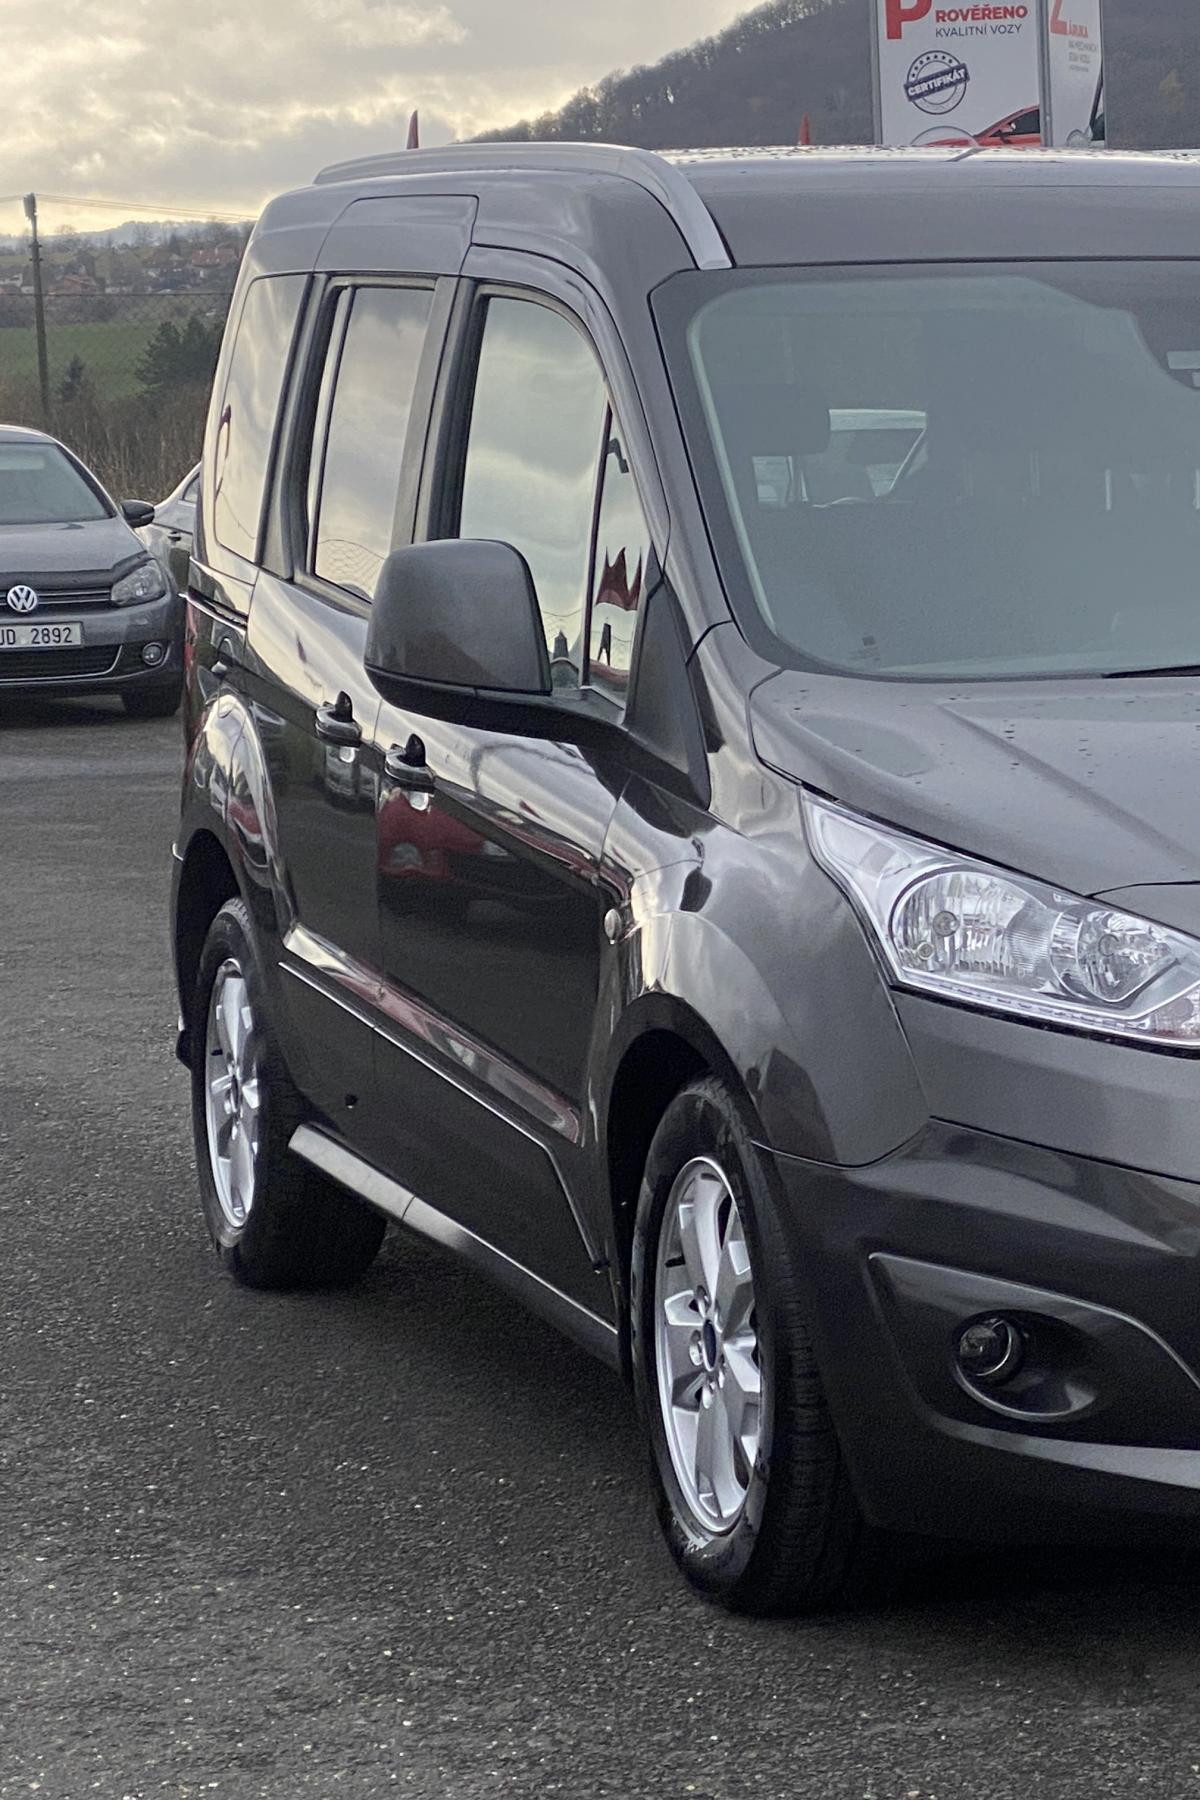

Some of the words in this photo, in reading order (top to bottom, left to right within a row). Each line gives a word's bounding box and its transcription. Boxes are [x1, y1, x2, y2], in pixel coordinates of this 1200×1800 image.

[935, 23, 987, 38] KVALITNÍ
[989, 23, 1022, 35] VOZY
[908, 67, 965, 96] CERTIFIKÁT
[30, 627, 73, 644] 2892
